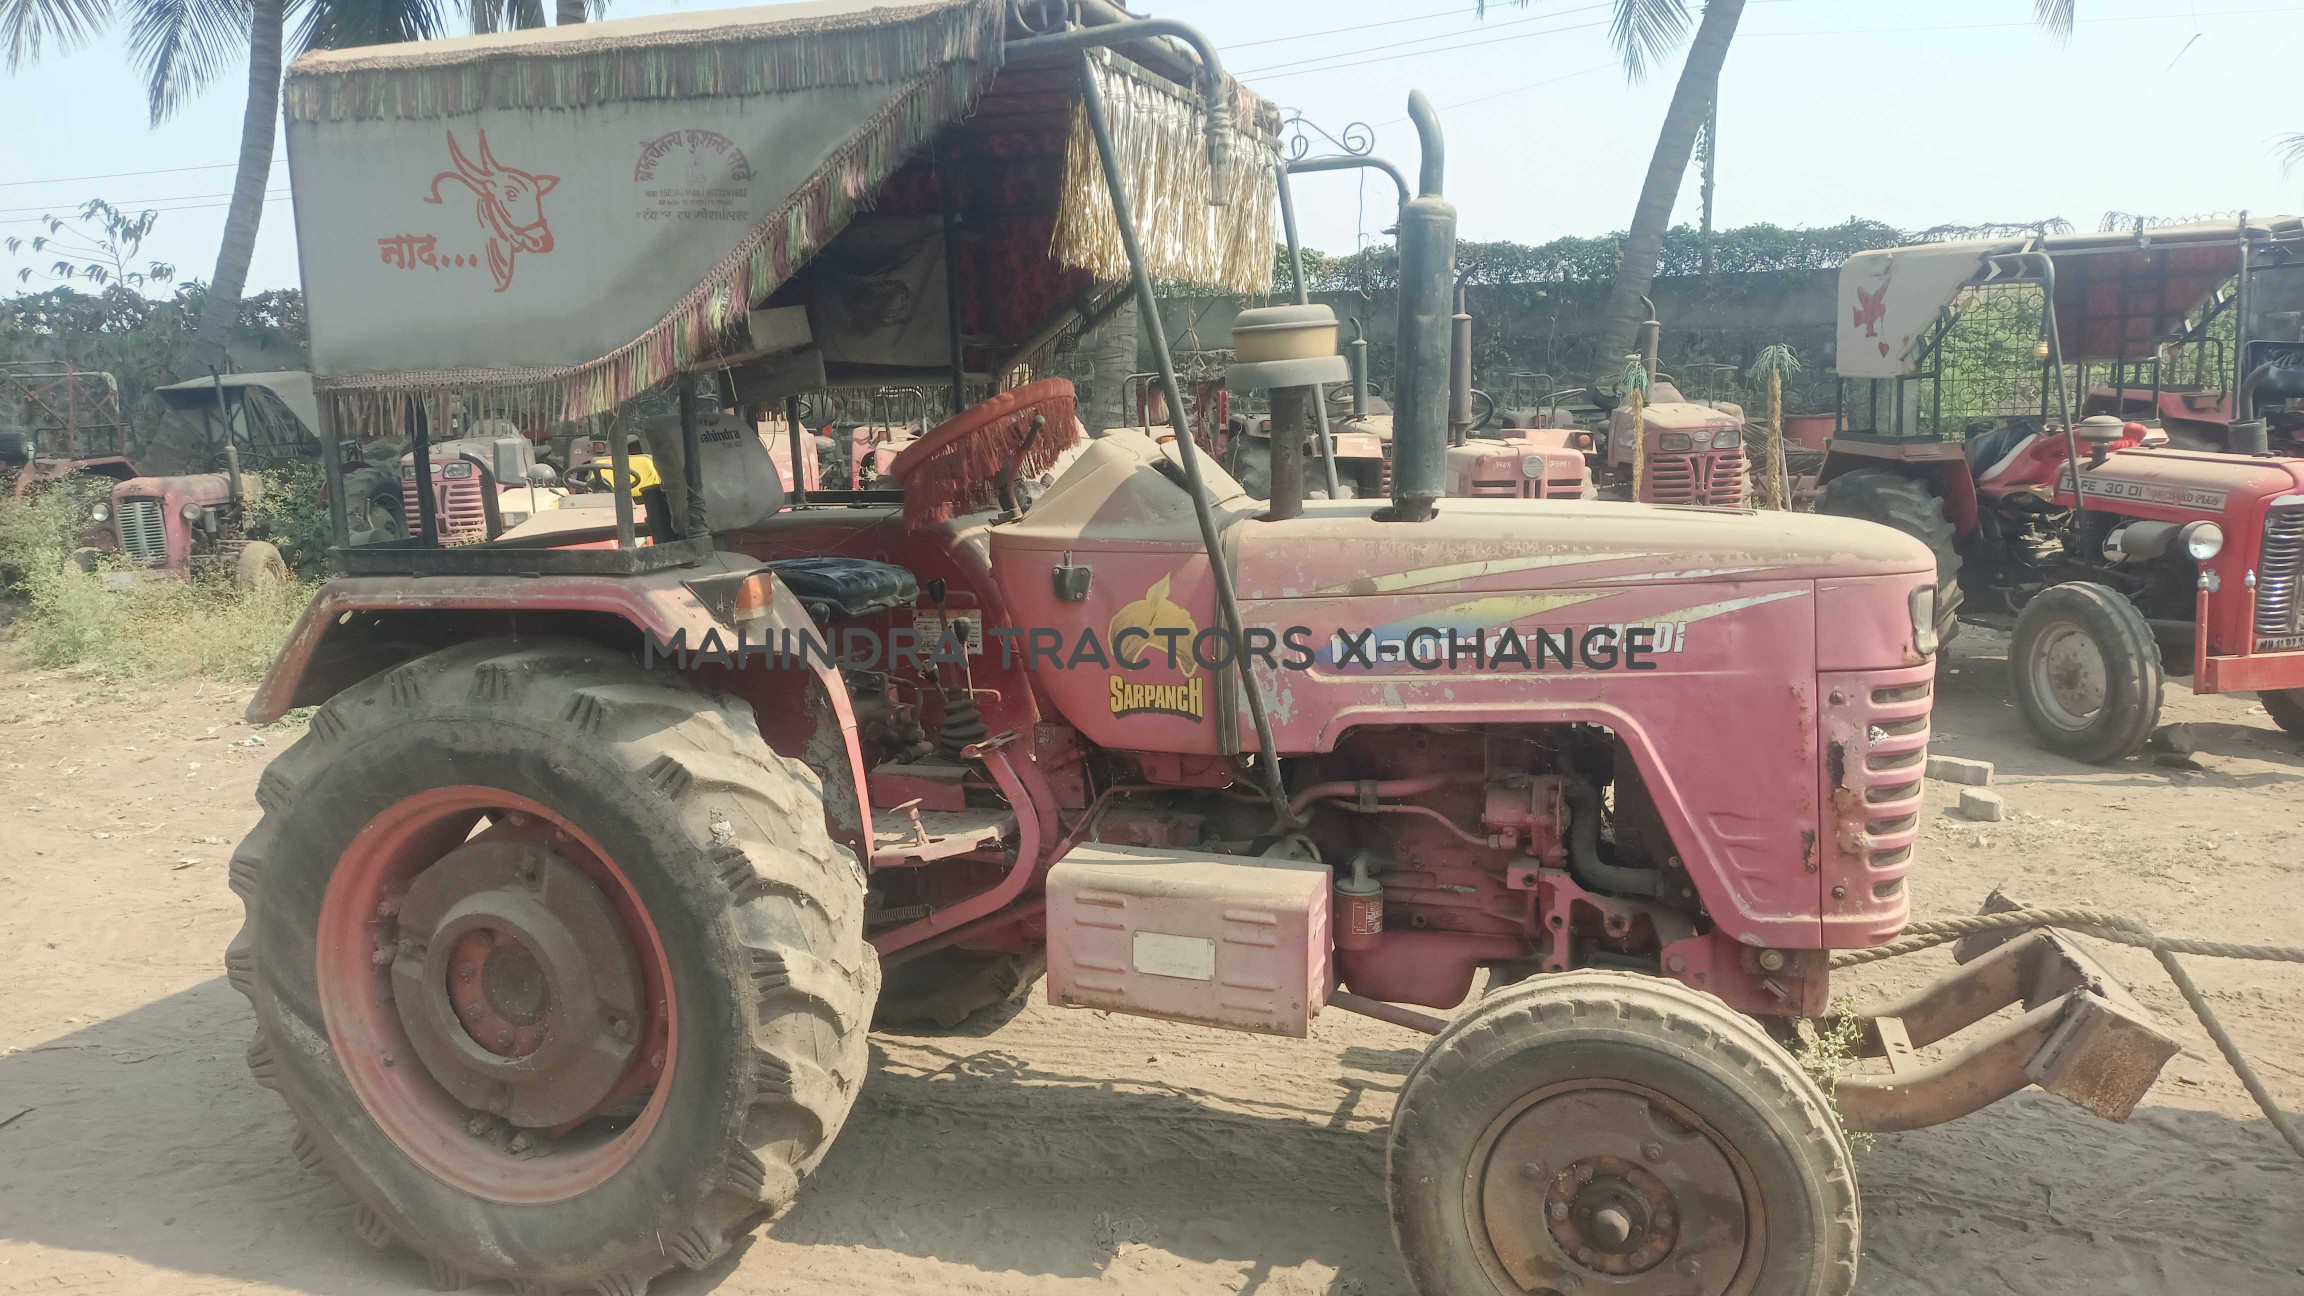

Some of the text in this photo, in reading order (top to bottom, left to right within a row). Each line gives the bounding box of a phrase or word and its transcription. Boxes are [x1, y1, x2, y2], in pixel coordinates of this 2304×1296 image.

[700, 428, 741, 444] ahindra
[2104, 483, 2123, 494] 30
[2128, 485, 2143, 497] DI
